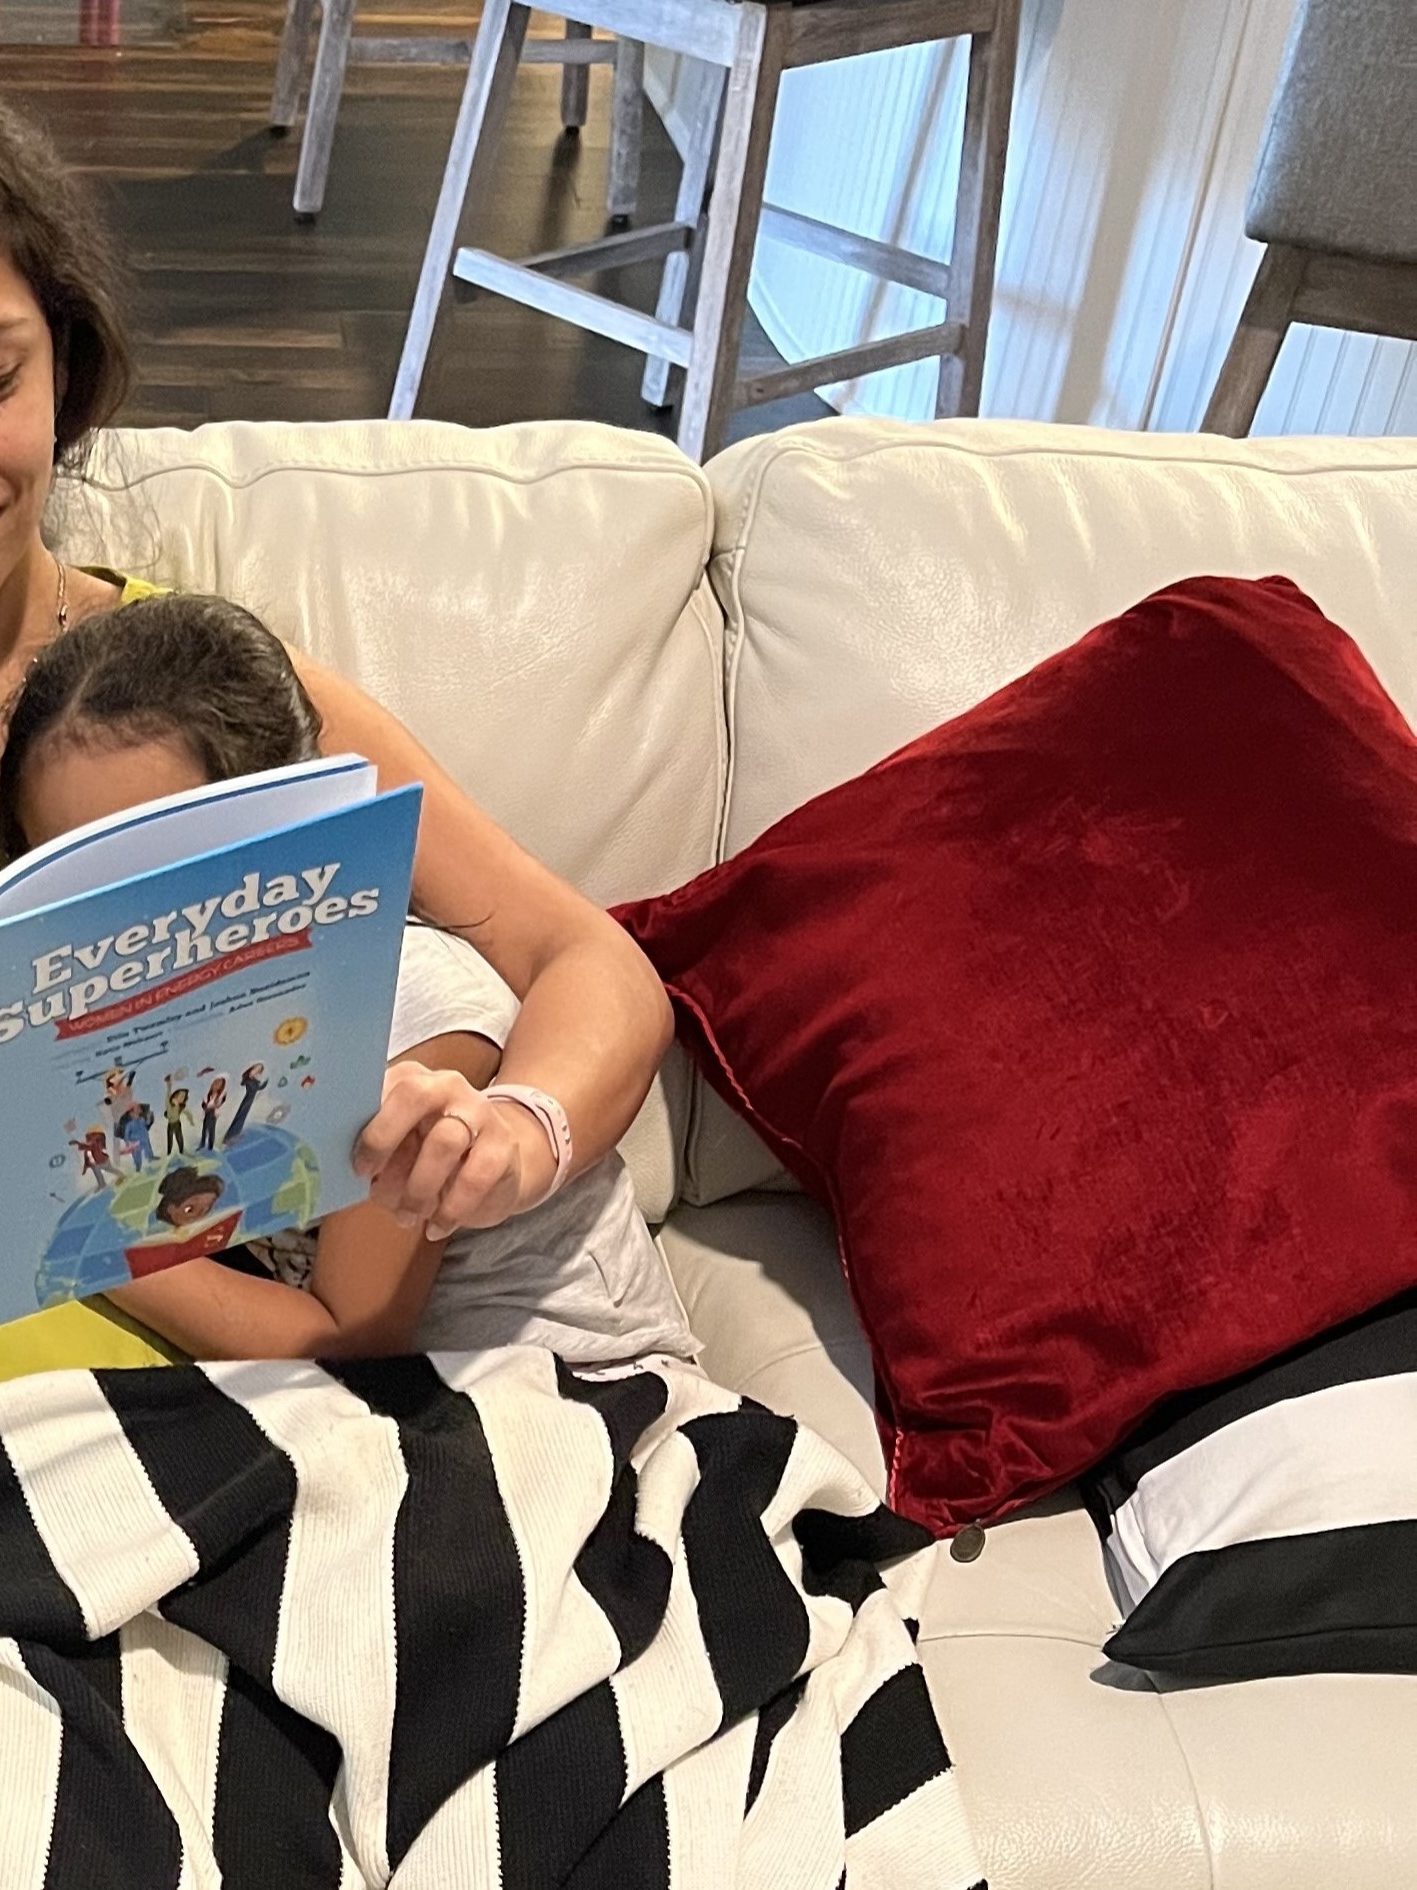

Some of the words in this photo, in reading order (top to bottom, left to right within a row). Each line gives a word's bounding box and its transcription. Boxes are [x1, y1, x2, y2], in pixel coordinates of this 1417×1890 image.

[32, 862, 342, 994] Everyday
[68, 1002, 132, 1032] WOMEN
[134, 994, 153, 1010] IN
[155, 964, 221, 1003] ENERGY
[221, 938, 300, 975] CAREERS
